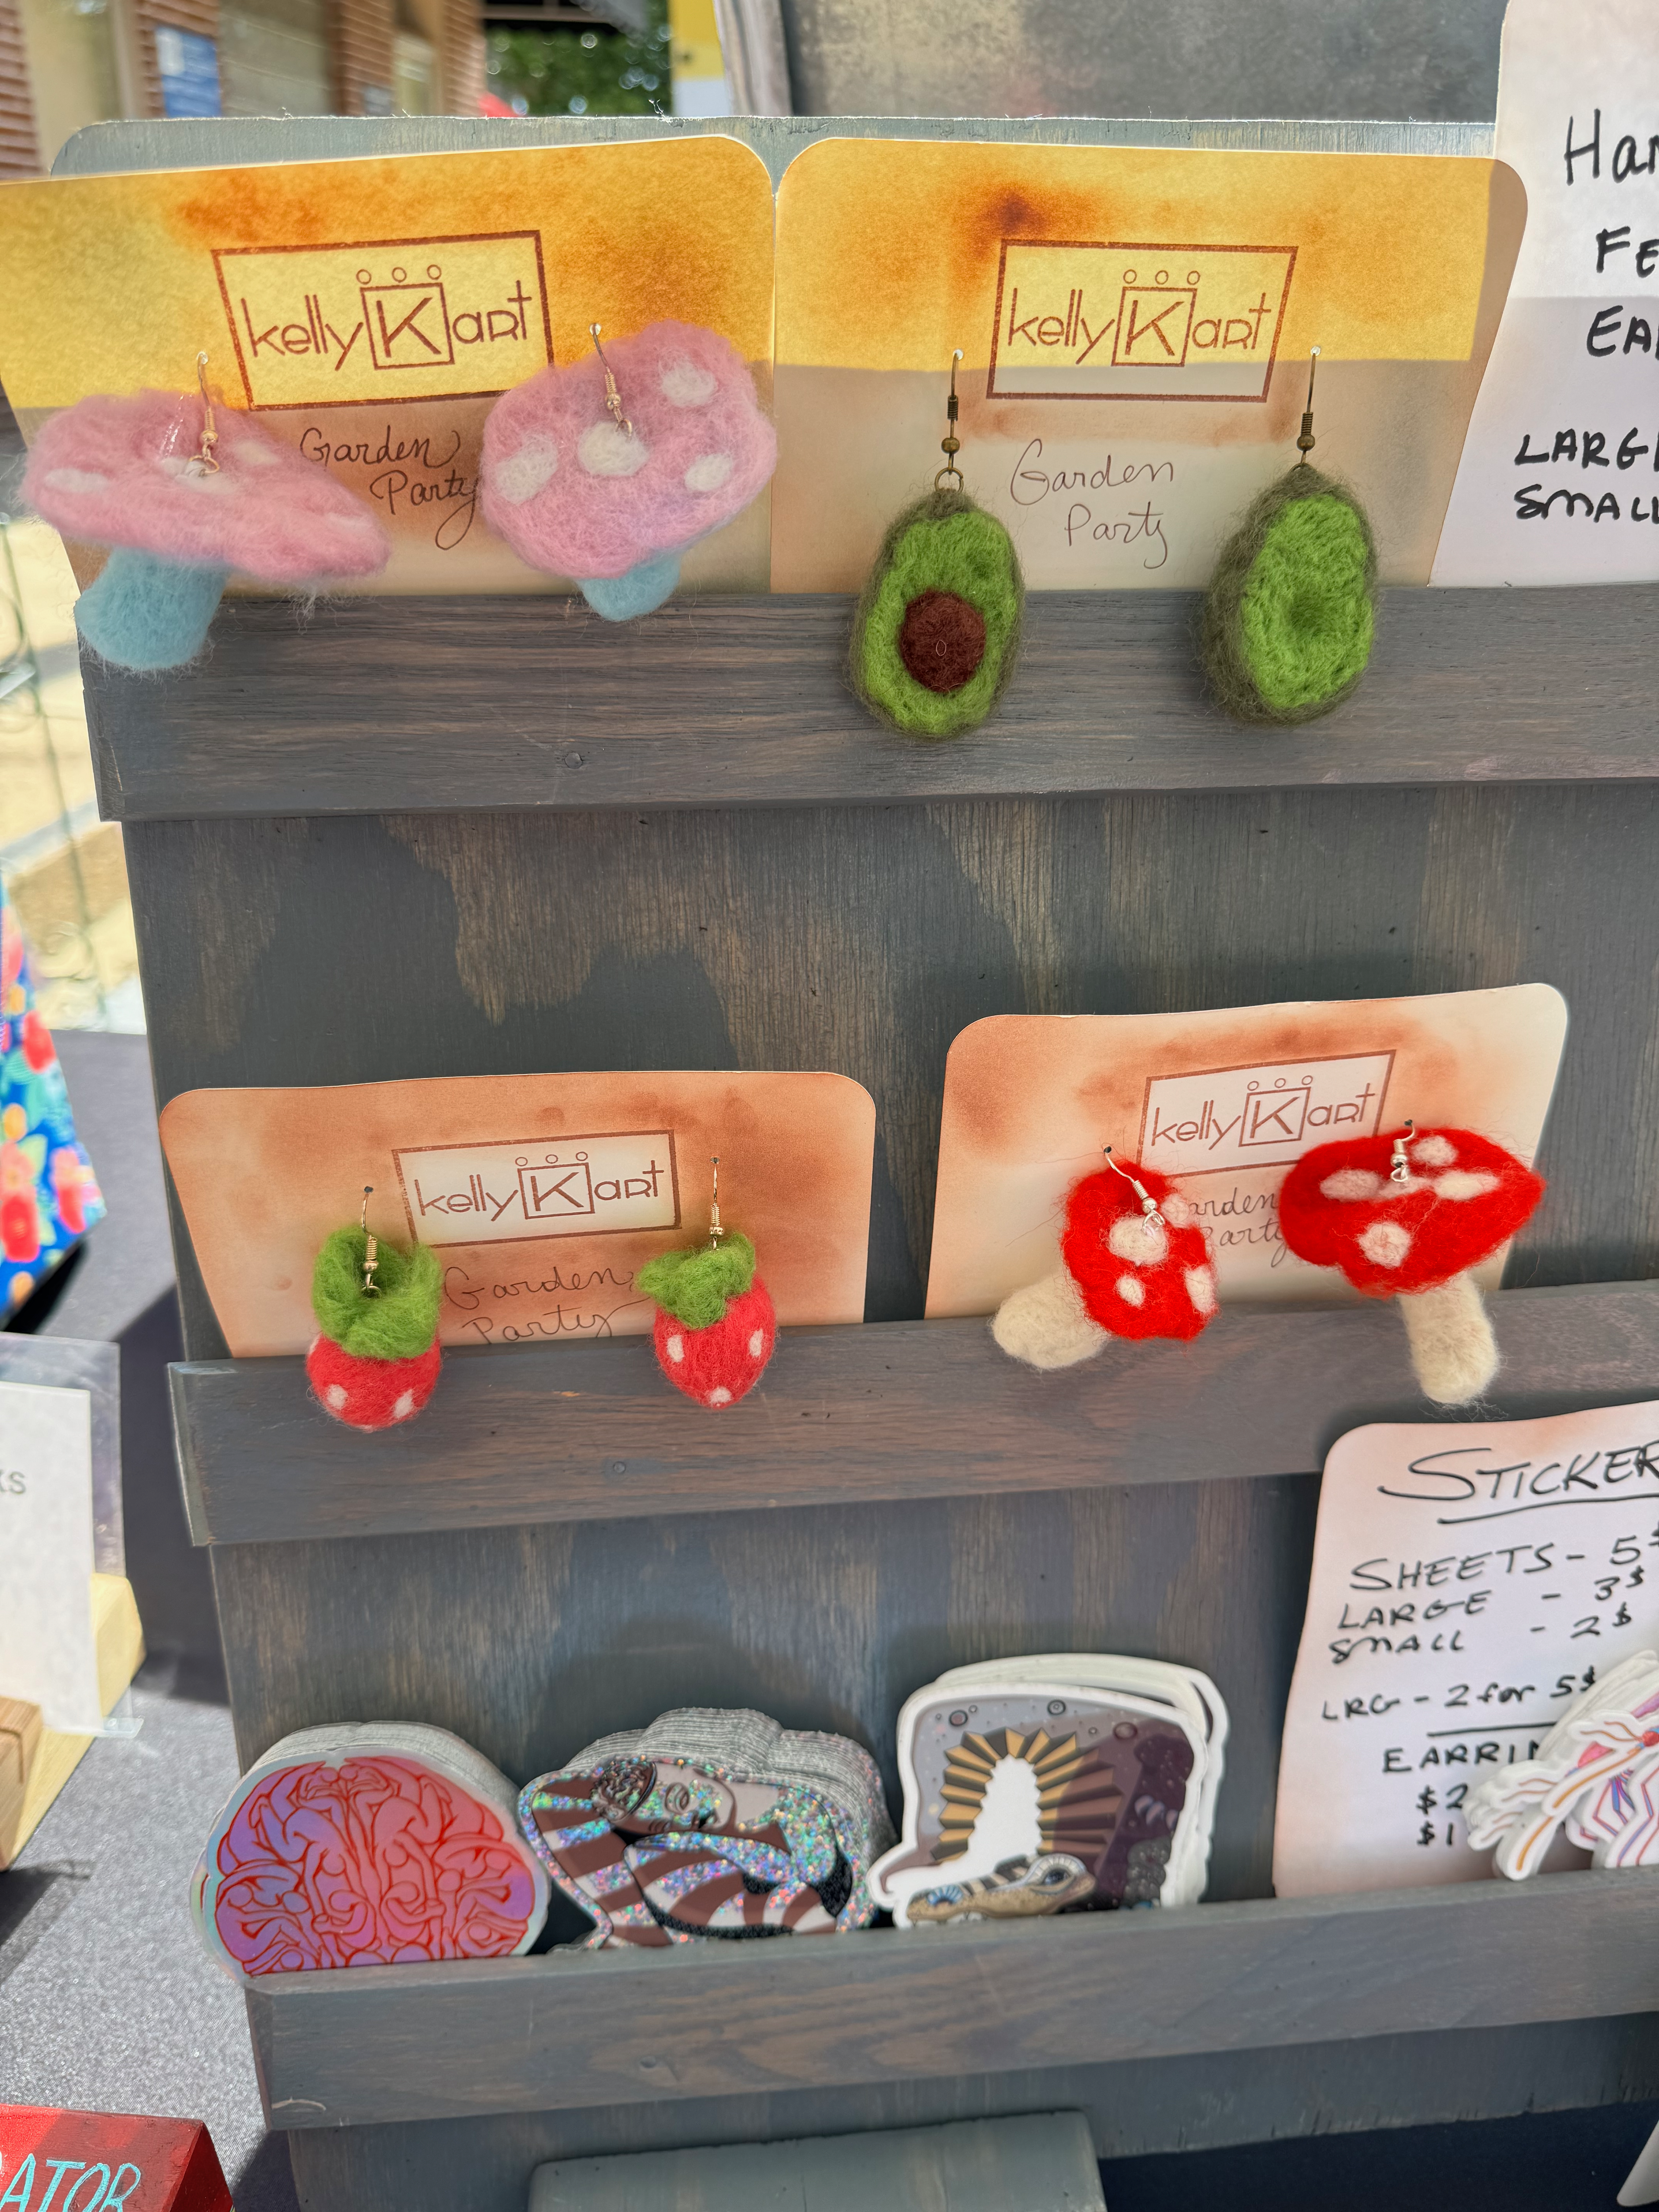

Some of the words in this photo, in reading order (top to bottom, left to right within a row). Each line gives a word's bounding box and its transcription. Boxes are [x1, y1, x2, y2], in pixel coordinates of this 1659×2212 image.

[240, 294, 364, 372] kelly
[376, 296, 442, 358] K
[1008, 288, 1115, 364] kelly
[1125, 300, 1185, 356] K
[300, 425, 461, 467] Garden
[1514, 427, 1659, 472] LARG
[1010, 438, 1174, 505] Garden
[370, 470, 481, 551] Party
[1065, 501, 1168, 569] Party
[1151, 1100, 1241, 1150] kelly
[1249, 1096, 1300, 1139] K
[414, 1174, 518, 1221] kelly
[531, 1172, 584, 1211] K
[1188, 1187, 1280, 1217] arden
[444, 1266, 634, 1310] Garden
[1337, 1589, 1492, 1630] LARGE
[1328, 1629, 1465, 1665] SMALL
[1476, 1682, 1535, 1702] for
